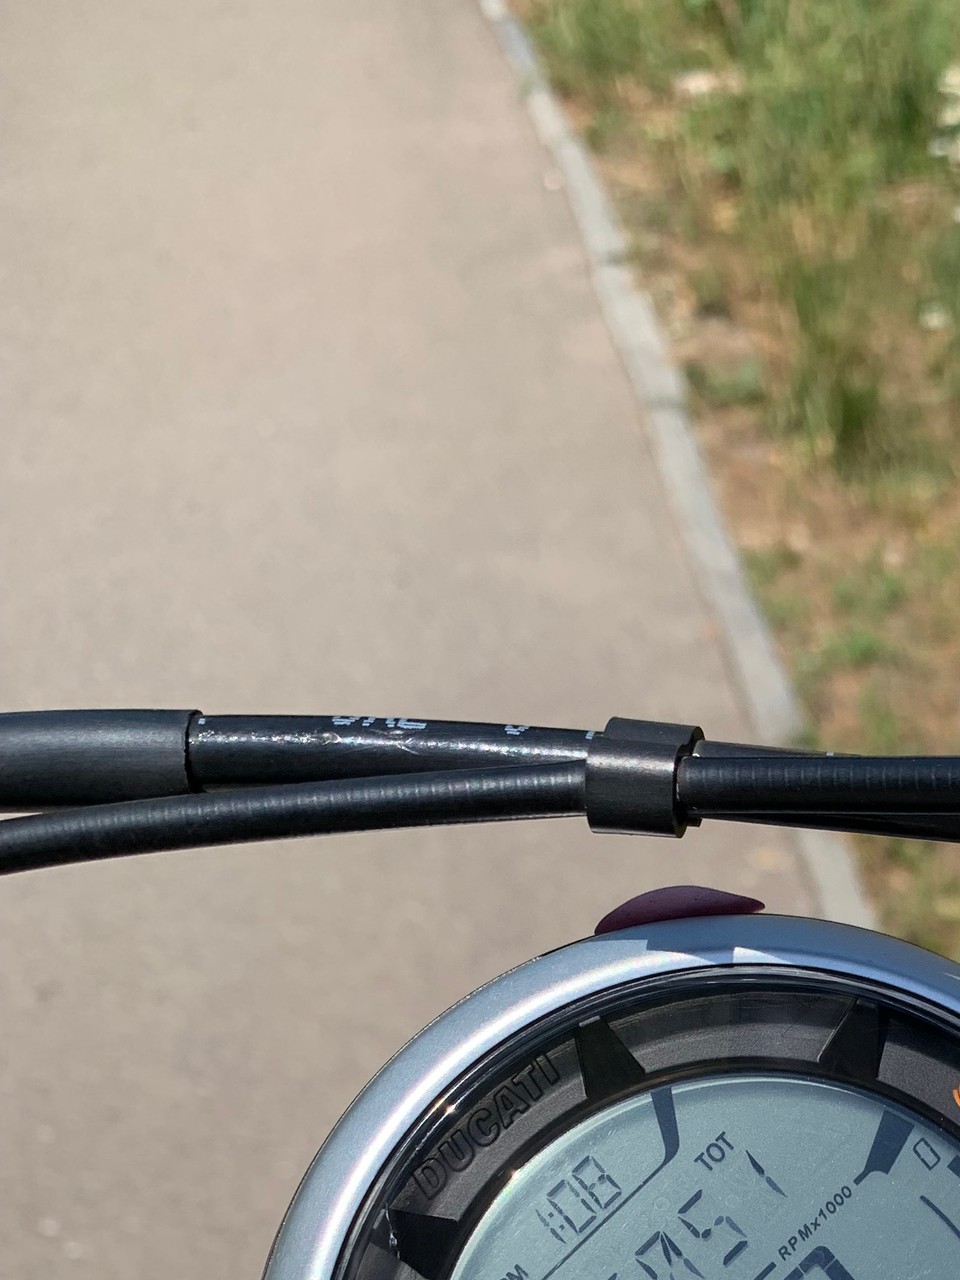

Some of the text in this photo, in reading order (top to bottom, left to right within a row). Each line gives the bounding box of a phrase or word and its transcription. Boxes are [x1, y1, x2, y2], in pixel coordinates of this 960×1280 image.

[412, 1053, 561, 1202] DUCATI
[694, 1131, 735, 1172] TOT
[778, 1185, 853, 1262] RPMx1000
